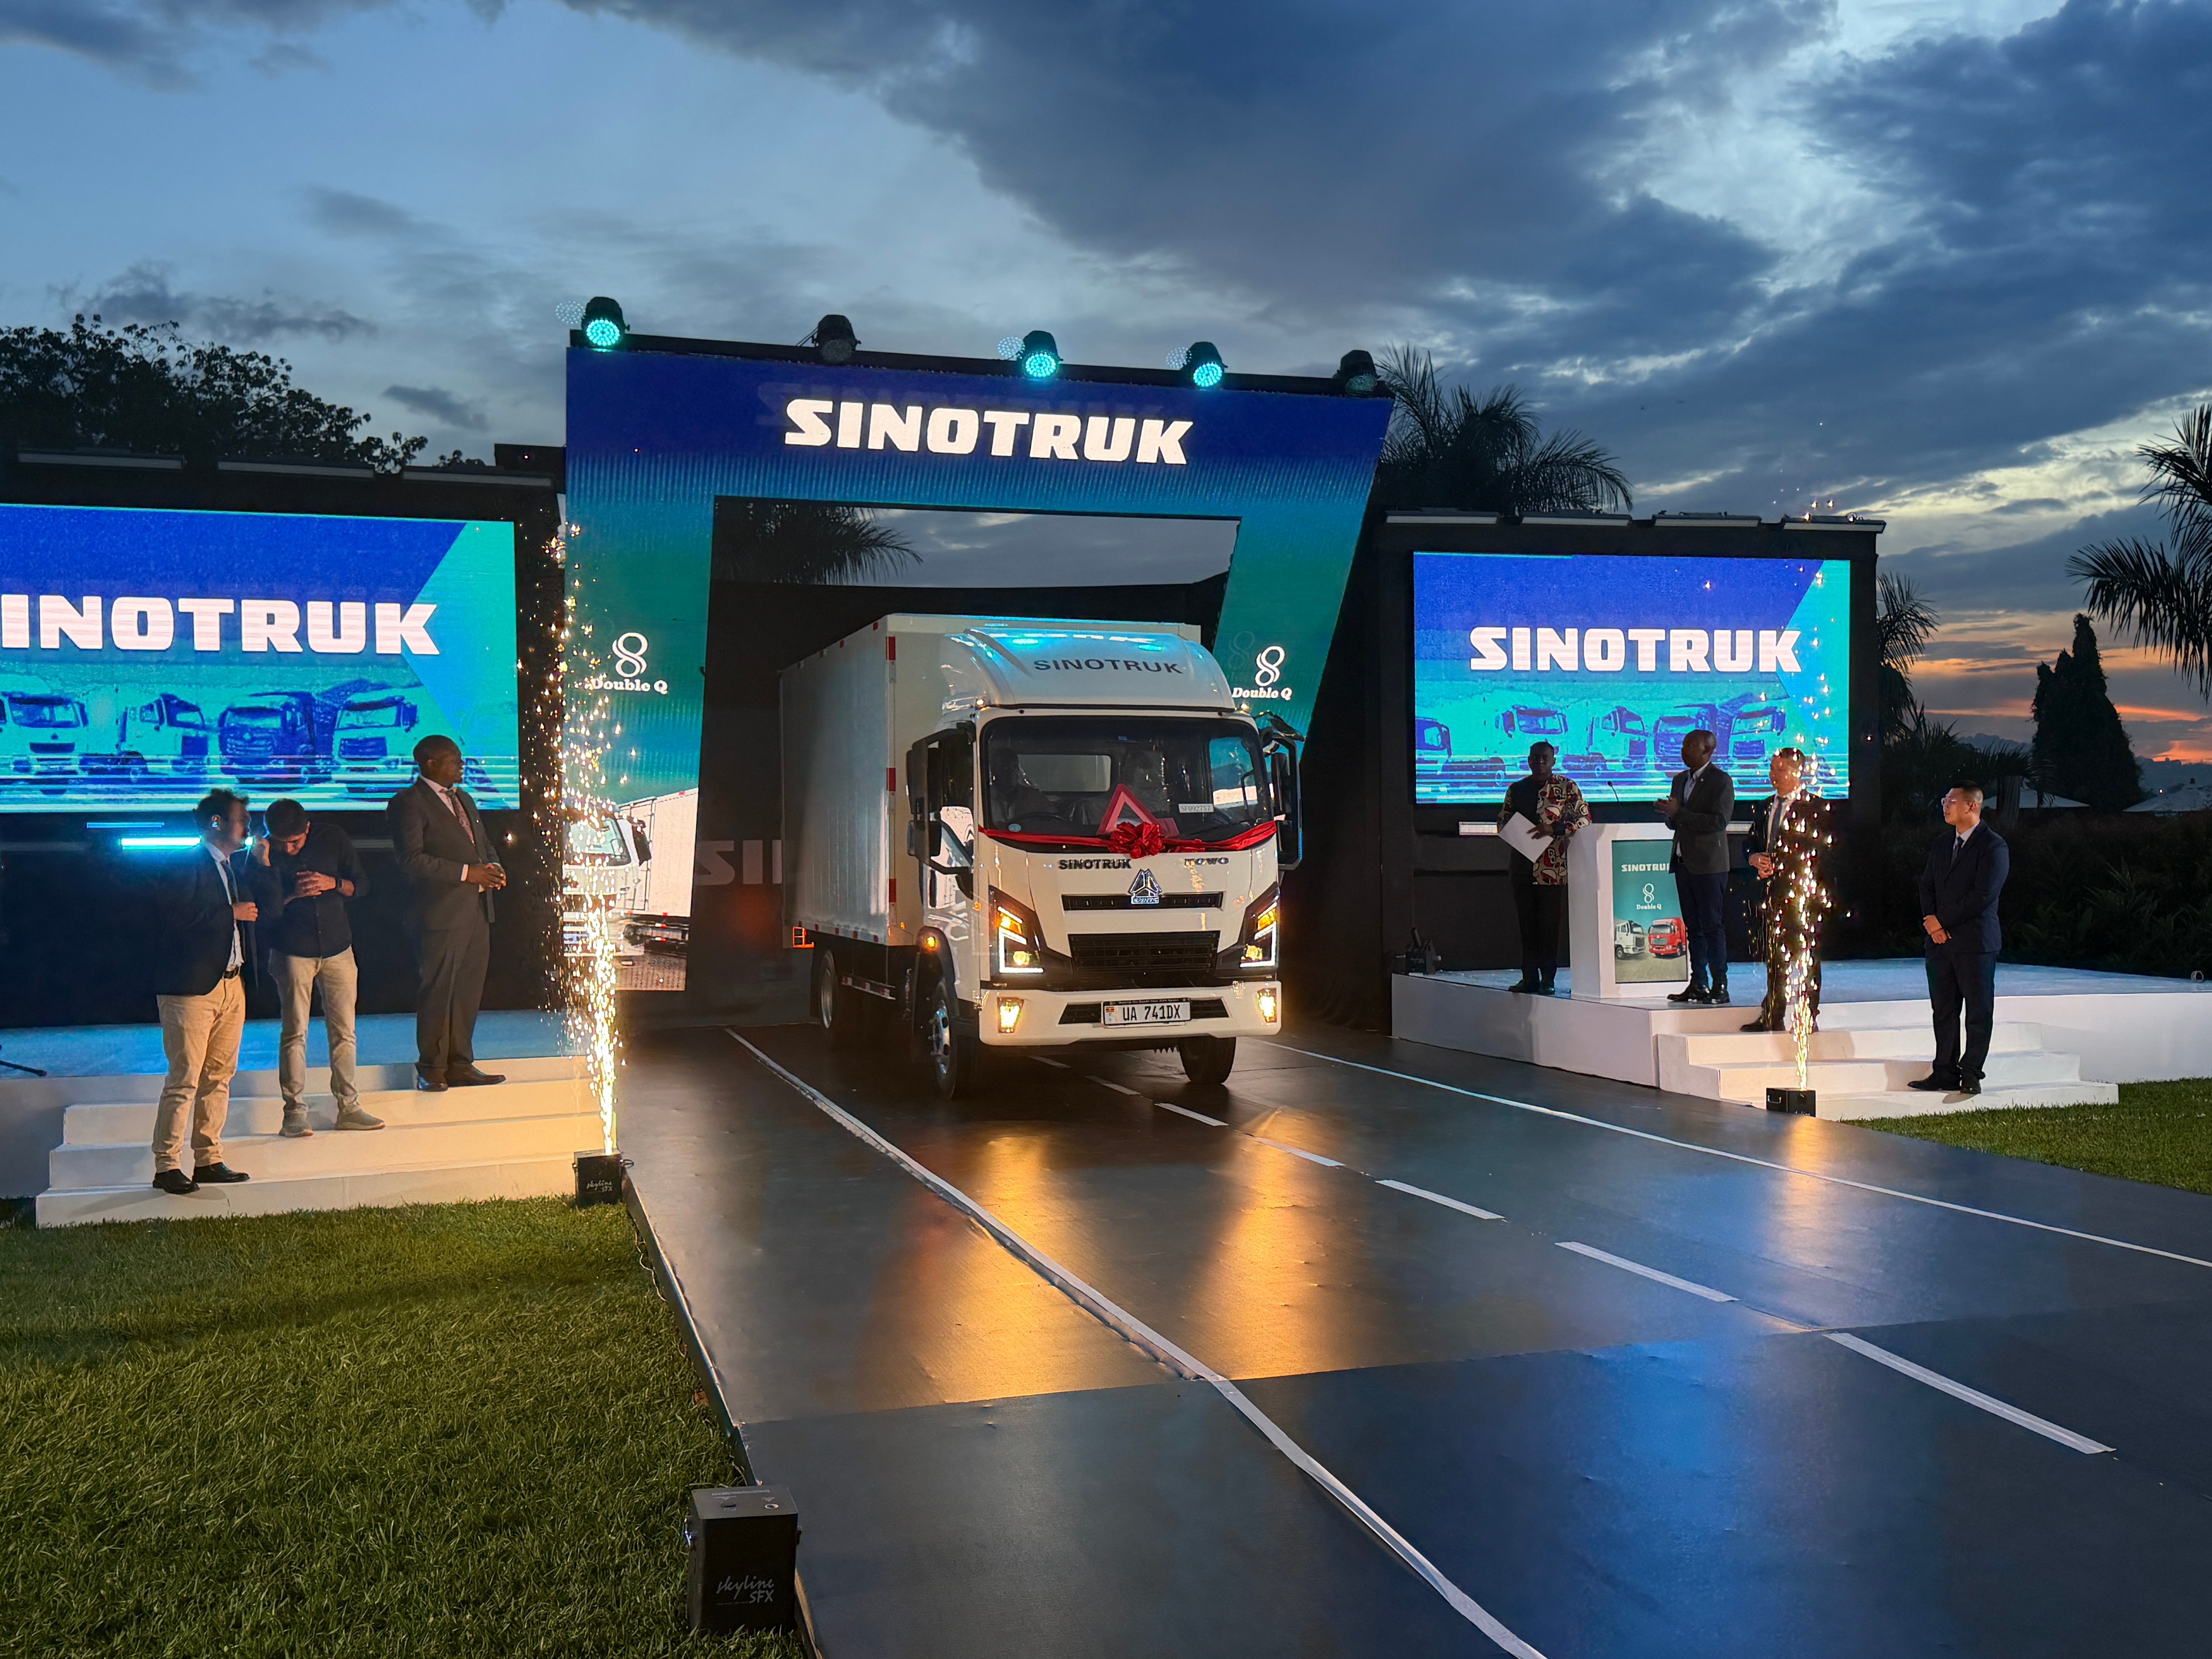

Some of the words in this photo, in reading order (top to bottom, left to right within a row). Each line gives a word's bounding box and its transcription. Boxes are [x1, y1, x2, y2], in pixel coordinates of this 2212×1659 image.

[785, 399, 1193, 465] SINOTRUK
[1, 594, 440, 655] INOTRUK
[1470, 627, 1802, 672] SINOTRUK
[1034, 659, 1183, 674] SINOTRUK
[591, 678, 651, 692] Double
[654, 680, 668, 694] Q
[1231, 687, 1279, 699] Double
[1281, 687, 1292, 701] Q
[1059, 858, 1132, 870] SINOTRUK
[1123, 1006, 1137, 1021] UA
[1144, 1005, 1181, 1020] 741DX
[749, 1589, 774, 1603] SFX
